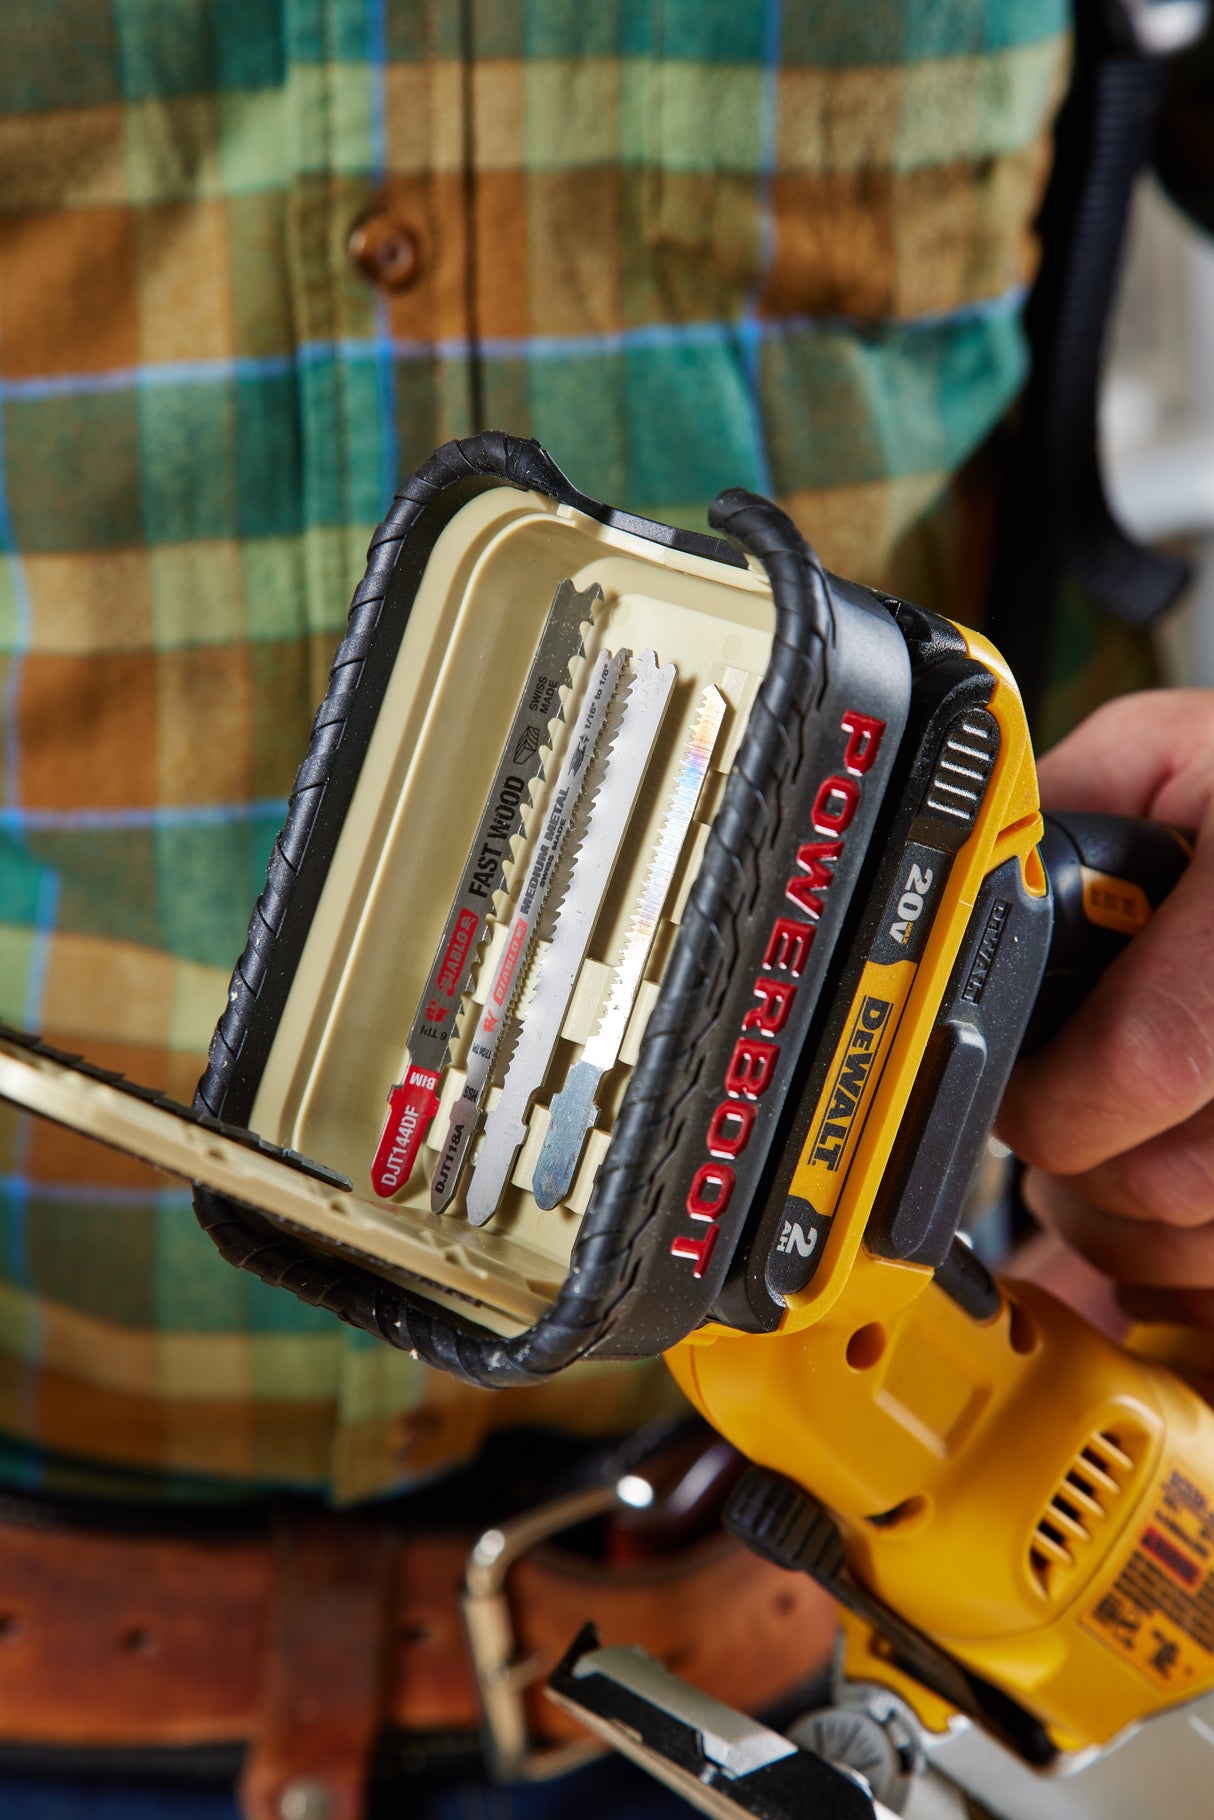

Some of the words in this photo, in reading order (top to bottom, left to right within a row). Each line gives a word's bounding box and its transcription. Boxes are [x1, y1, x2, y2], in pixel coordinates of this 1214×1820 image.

[529, 676, 548, 711] SWISS
[540, 680, 558, 714] MADE
[469, 843, 502, 898] FAST
[487, 775, 525, 840] WOOD
[520, 845, 550, 915] MEDIUM
[544, 786, 570, 841] METAL
[540, 854, 554, 888] SWISS
[551, 819, 566, 850] MADE
[889, 863, 934, 944] 20V
[442, 930, 469, 989] DIABLO
[495, 940, 519, 999] DIABLO
[963, 903, 1006, 1005] DEWALT
[671, 709, 886, 1279] POWERBOOT
[420, 1025, 437, 1039] TPI
[440, 1032, 448, 1041] 6
[409, 1072, 436, 1090] BIM
[464, 1085, 479, 1103] HSS
[813, 996, 892, 1172] DEWALT
[381, 1104, 420, 1187] DJT144DF
[435, 1124, 464, 1194] DJT118A
[788, 1222, 818, 1258] 2
